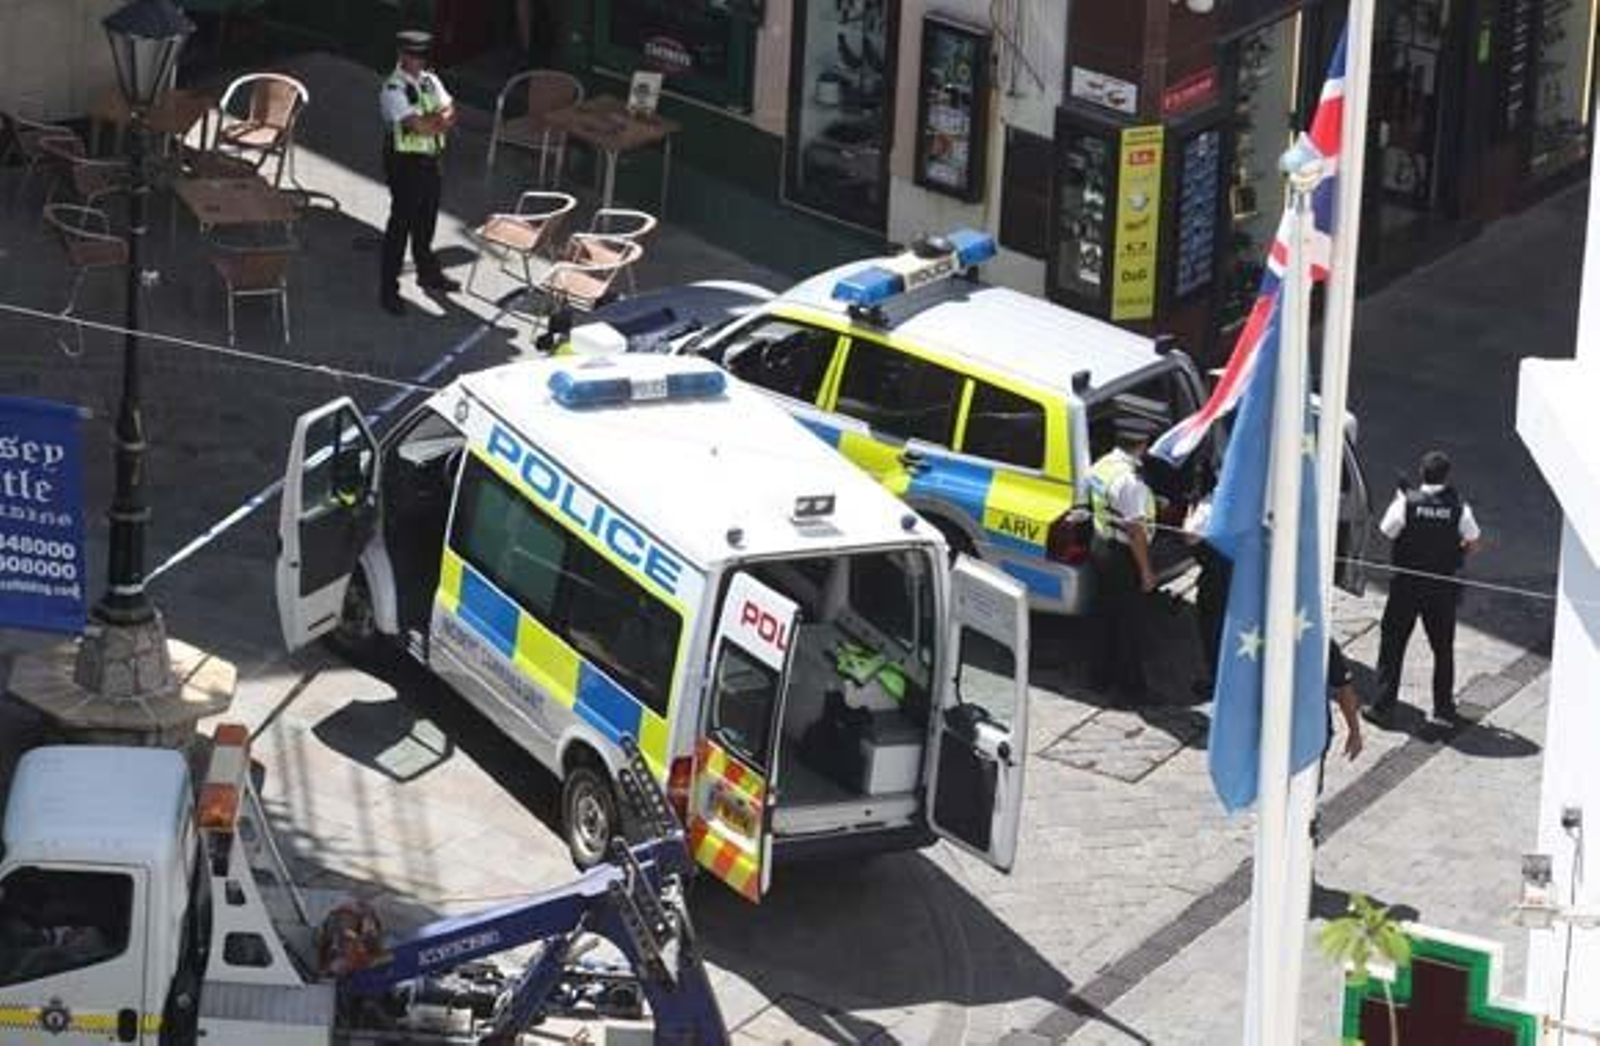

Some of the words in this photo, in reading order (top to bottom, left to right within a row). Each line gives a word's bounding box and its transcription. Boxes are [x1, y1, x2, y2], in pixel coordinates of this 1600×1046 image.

[486, 424, 683, 595] POLICE
[1416, 506, 1451, 519] POLICE
[1000, 513, 1041, 540] ARV
